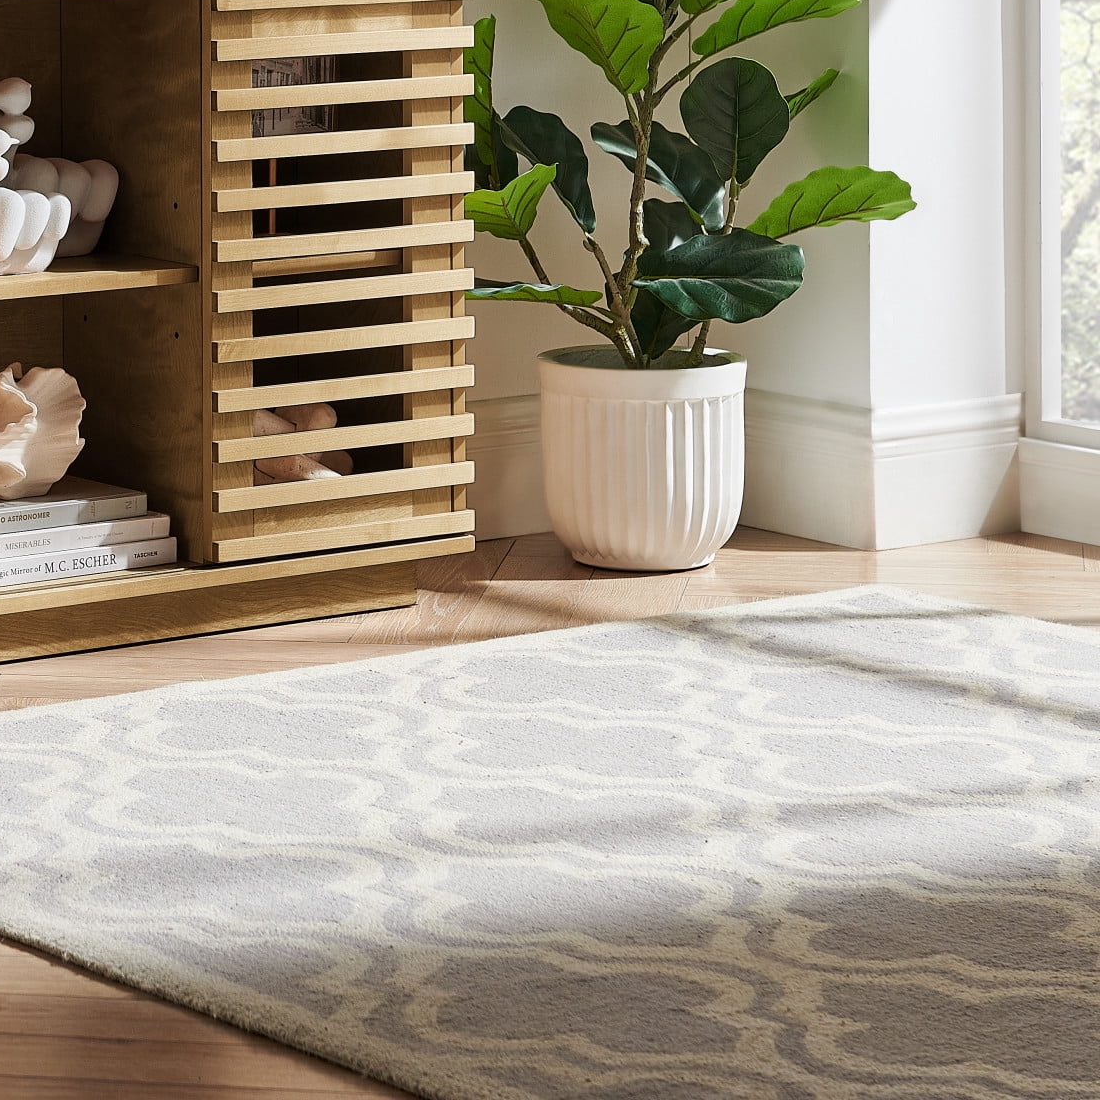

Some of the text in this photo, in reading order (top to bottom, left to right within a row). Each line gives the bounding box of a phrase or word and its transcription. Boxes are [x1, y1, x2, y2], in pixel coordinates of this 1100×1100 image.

[7, 511, 51, 523] ASTRONOMER
[4, 538, 51, 551] MISERABLES
[133, 550, 158, 559] TASCHEN
[10, 567, 33, 576] Mirror
[34, 564, 42, 573] of
[44, 560, 70, 574] M.C.
[72, 553, 117, 571] ESCHER
